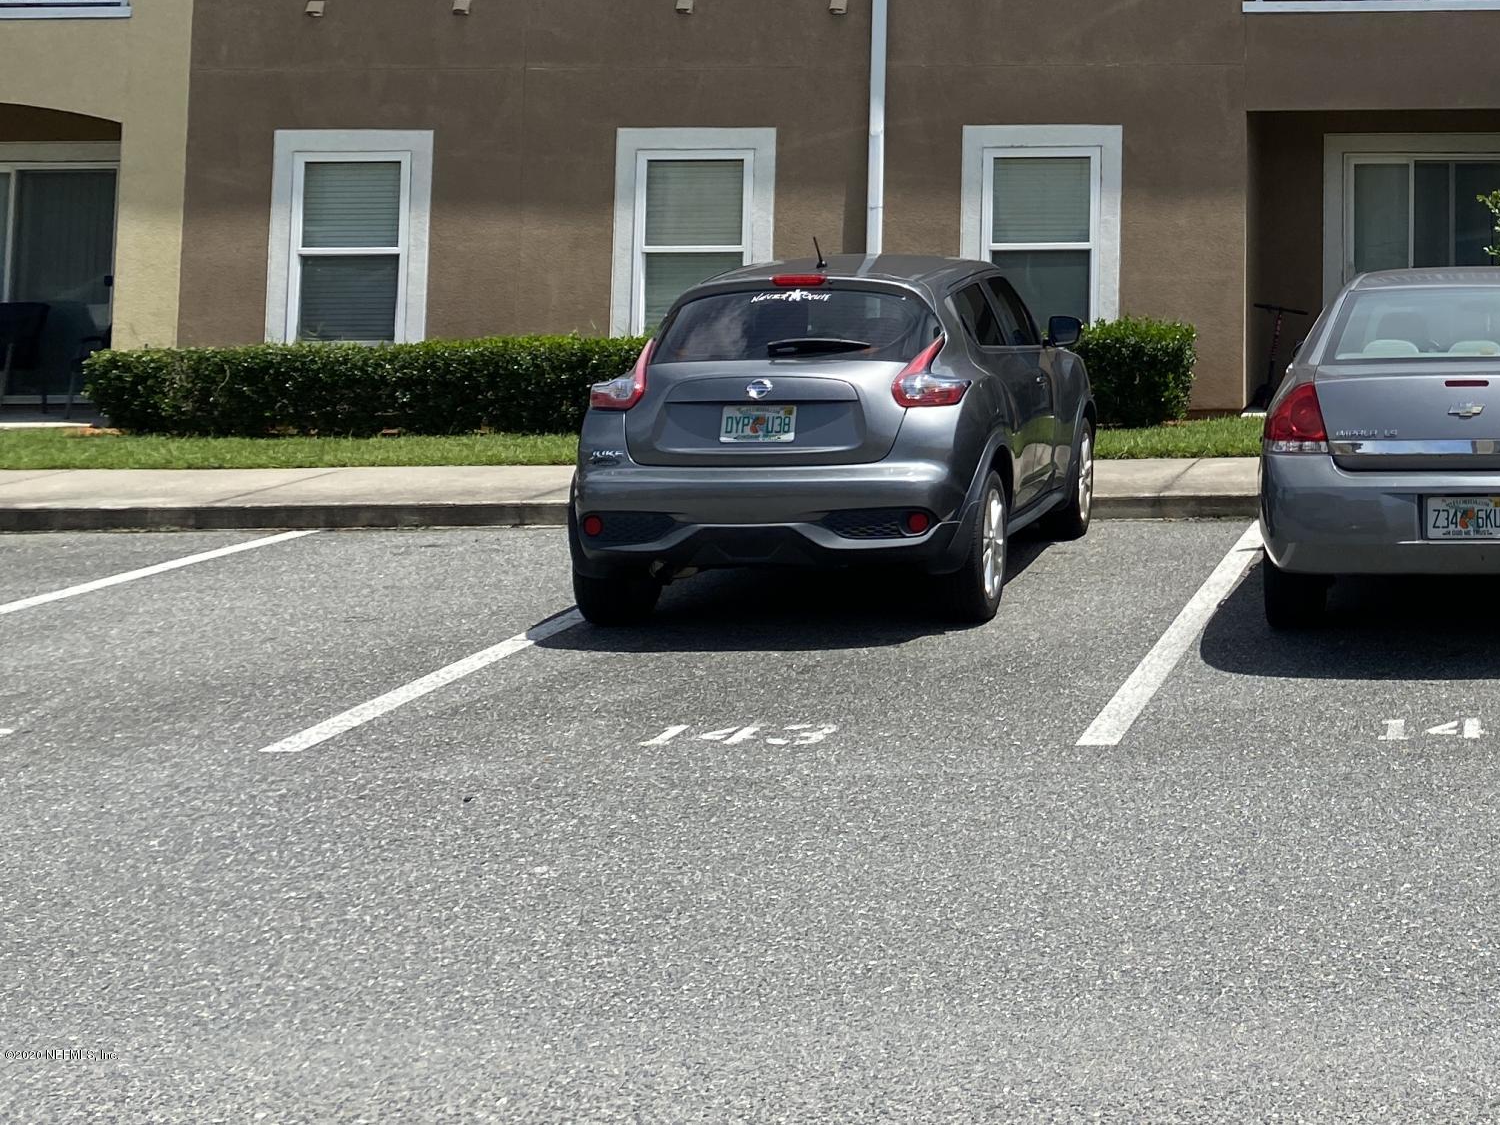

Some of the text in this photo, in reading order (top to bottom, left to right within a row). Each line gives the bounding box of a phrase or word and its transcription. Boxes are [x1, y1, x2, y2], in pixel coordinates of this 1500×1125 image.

[725, 416, 791, 434] DYP U38
[588, 450, 624, 460] JUKE
[1432, 509, 1458, 529] Z34
[638, 724, 840, 746] 143
